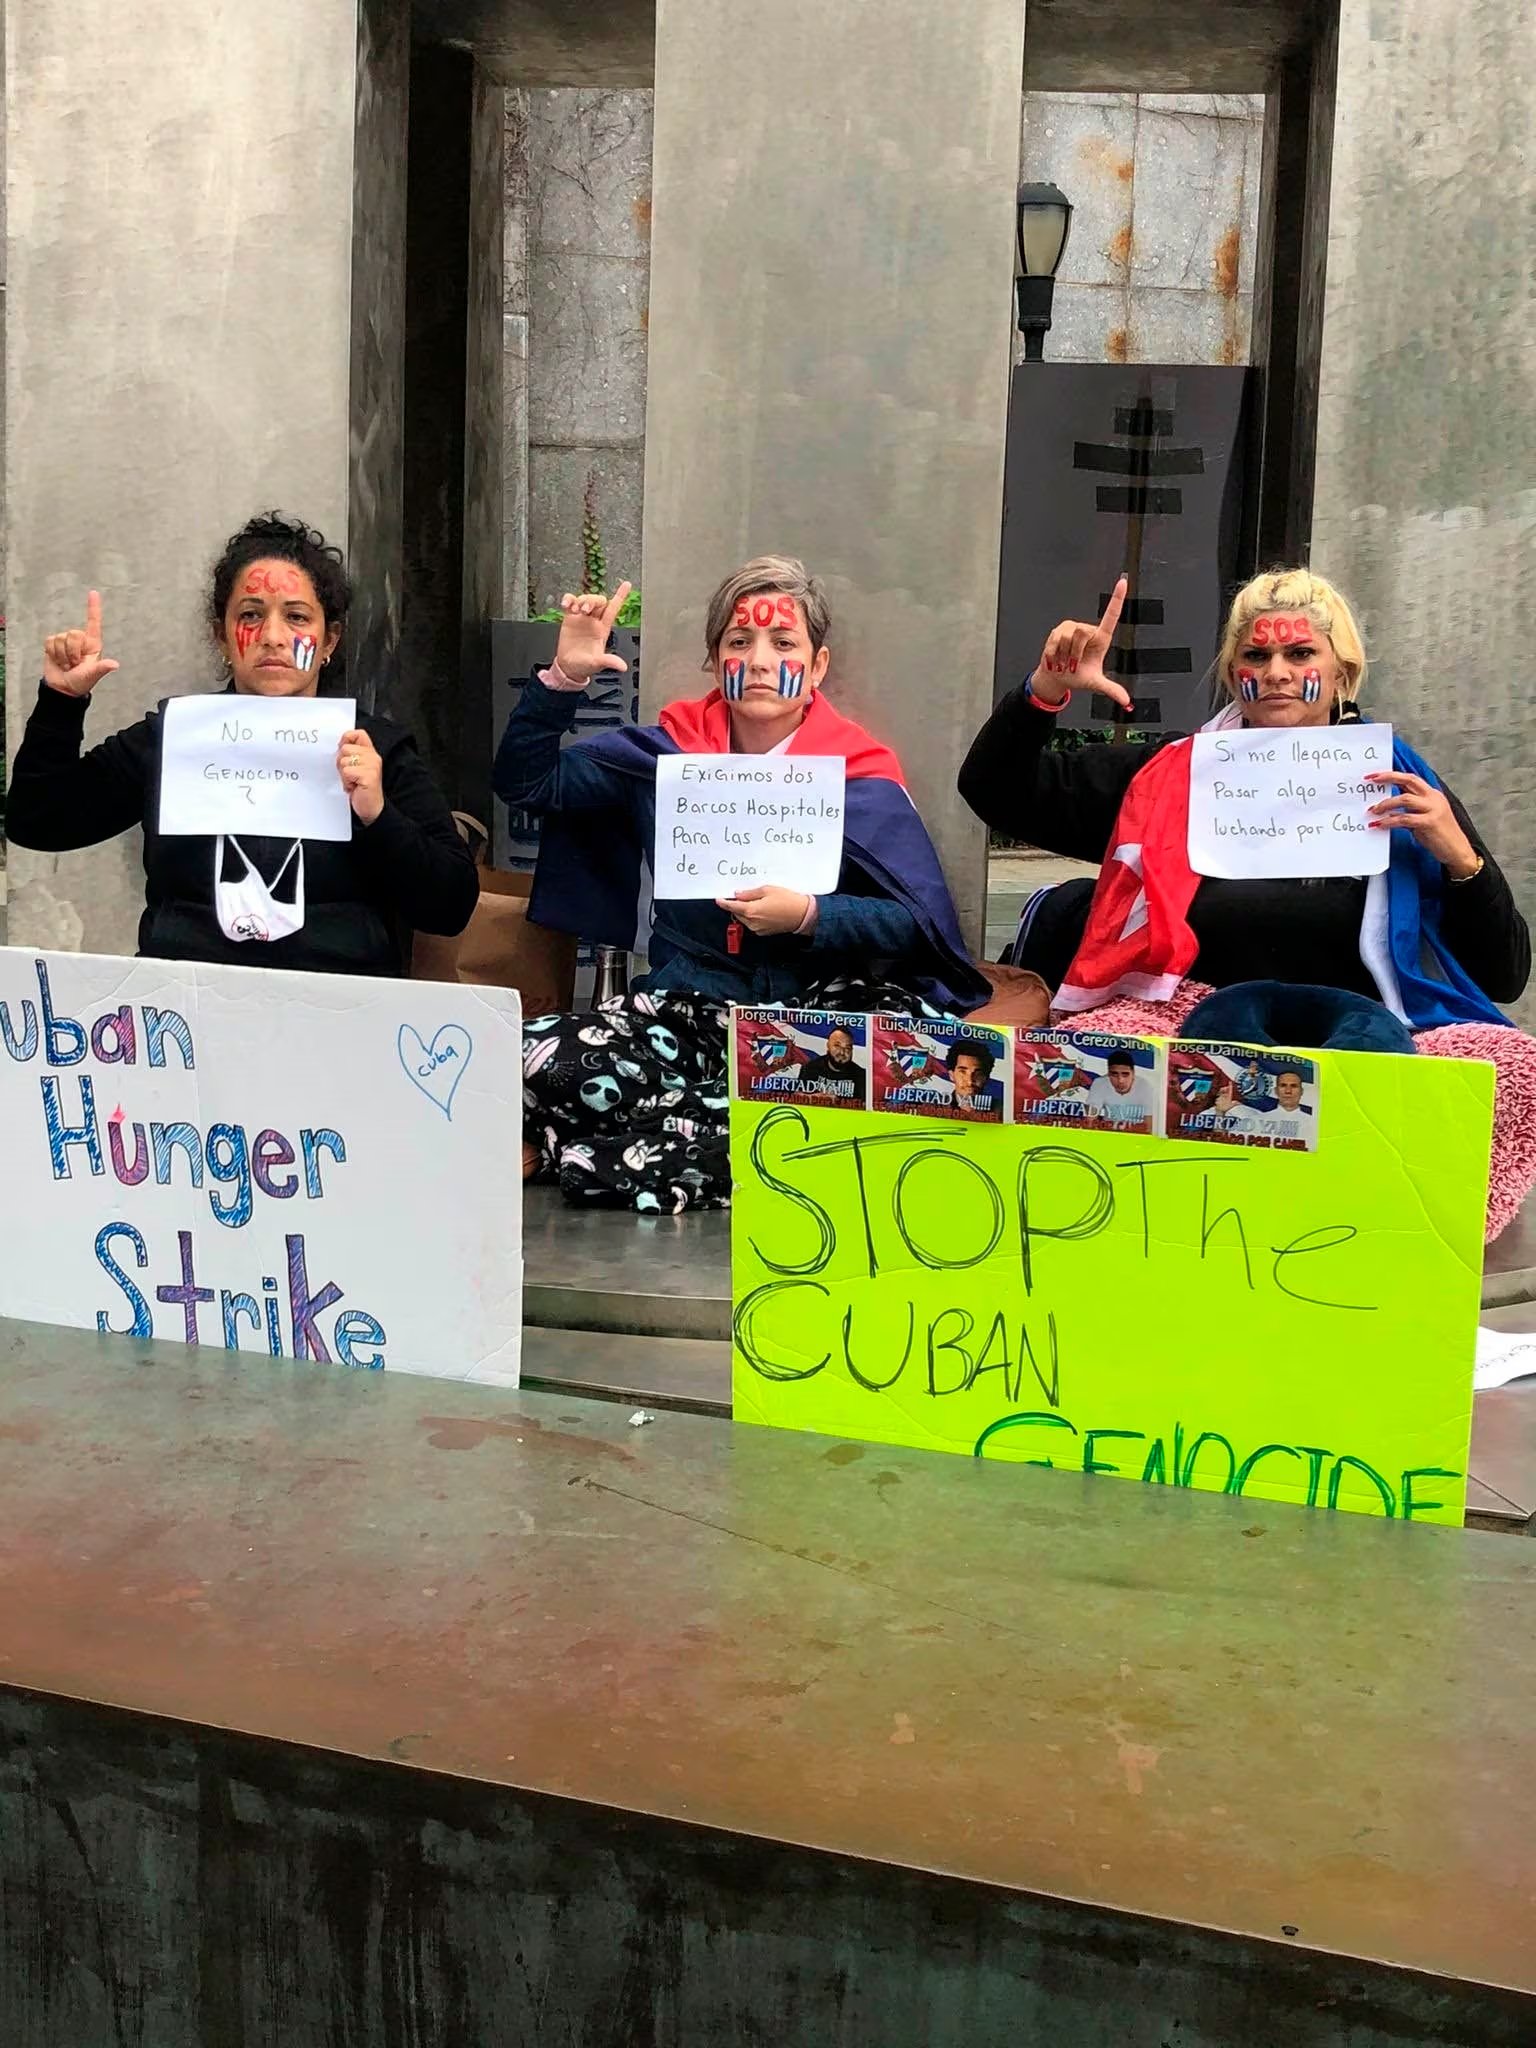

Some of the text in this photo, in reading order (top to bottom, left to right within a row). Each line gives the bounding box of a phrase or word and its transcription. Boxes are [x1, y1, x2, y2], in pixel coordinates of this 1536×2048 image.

[735, 596, 798, 630] SOS
[1252, 617, 1312, 646] SOS
[221, 719, 318, 743] No mas
[1215, 740, 1378, 769] Si me llegara a
[203, 762, 299, 781] GENOCIDIO
[783, 764, 813, 784] dos
[1277, 779, 1317, 804] algo
[676, 797, 840, 823] Barcos Hospitales
[724, 826, 751, 846] las
[1214, 817, 1286, 837] luchando
[1296, 825, 1324, 843] por
[676, 853, 699, 876] de
[738, 1009, 776, 1024] Jorge
[826, 1012, 866, 1028] Perez
[878, 1017, 999, 1042] Luis Manuel Otero
[1018, 1028, 1070, 1045] Leandro
[1072, 1031, 1118, 1048] Cerezo
[750, 1076, 817, 1094] LIBERTAD
[884, 1086, 953, 1106] LIBERTAD
[1022, 1099, 1100, 1118] LIBERTAD
[40, 1074, 347, 1229] Hunger
[749, 1105, 1115, 1297] STOP
[94, 1222, 387, 1370] Strike
[732, 1280, 1060, 1408] CUBAN
